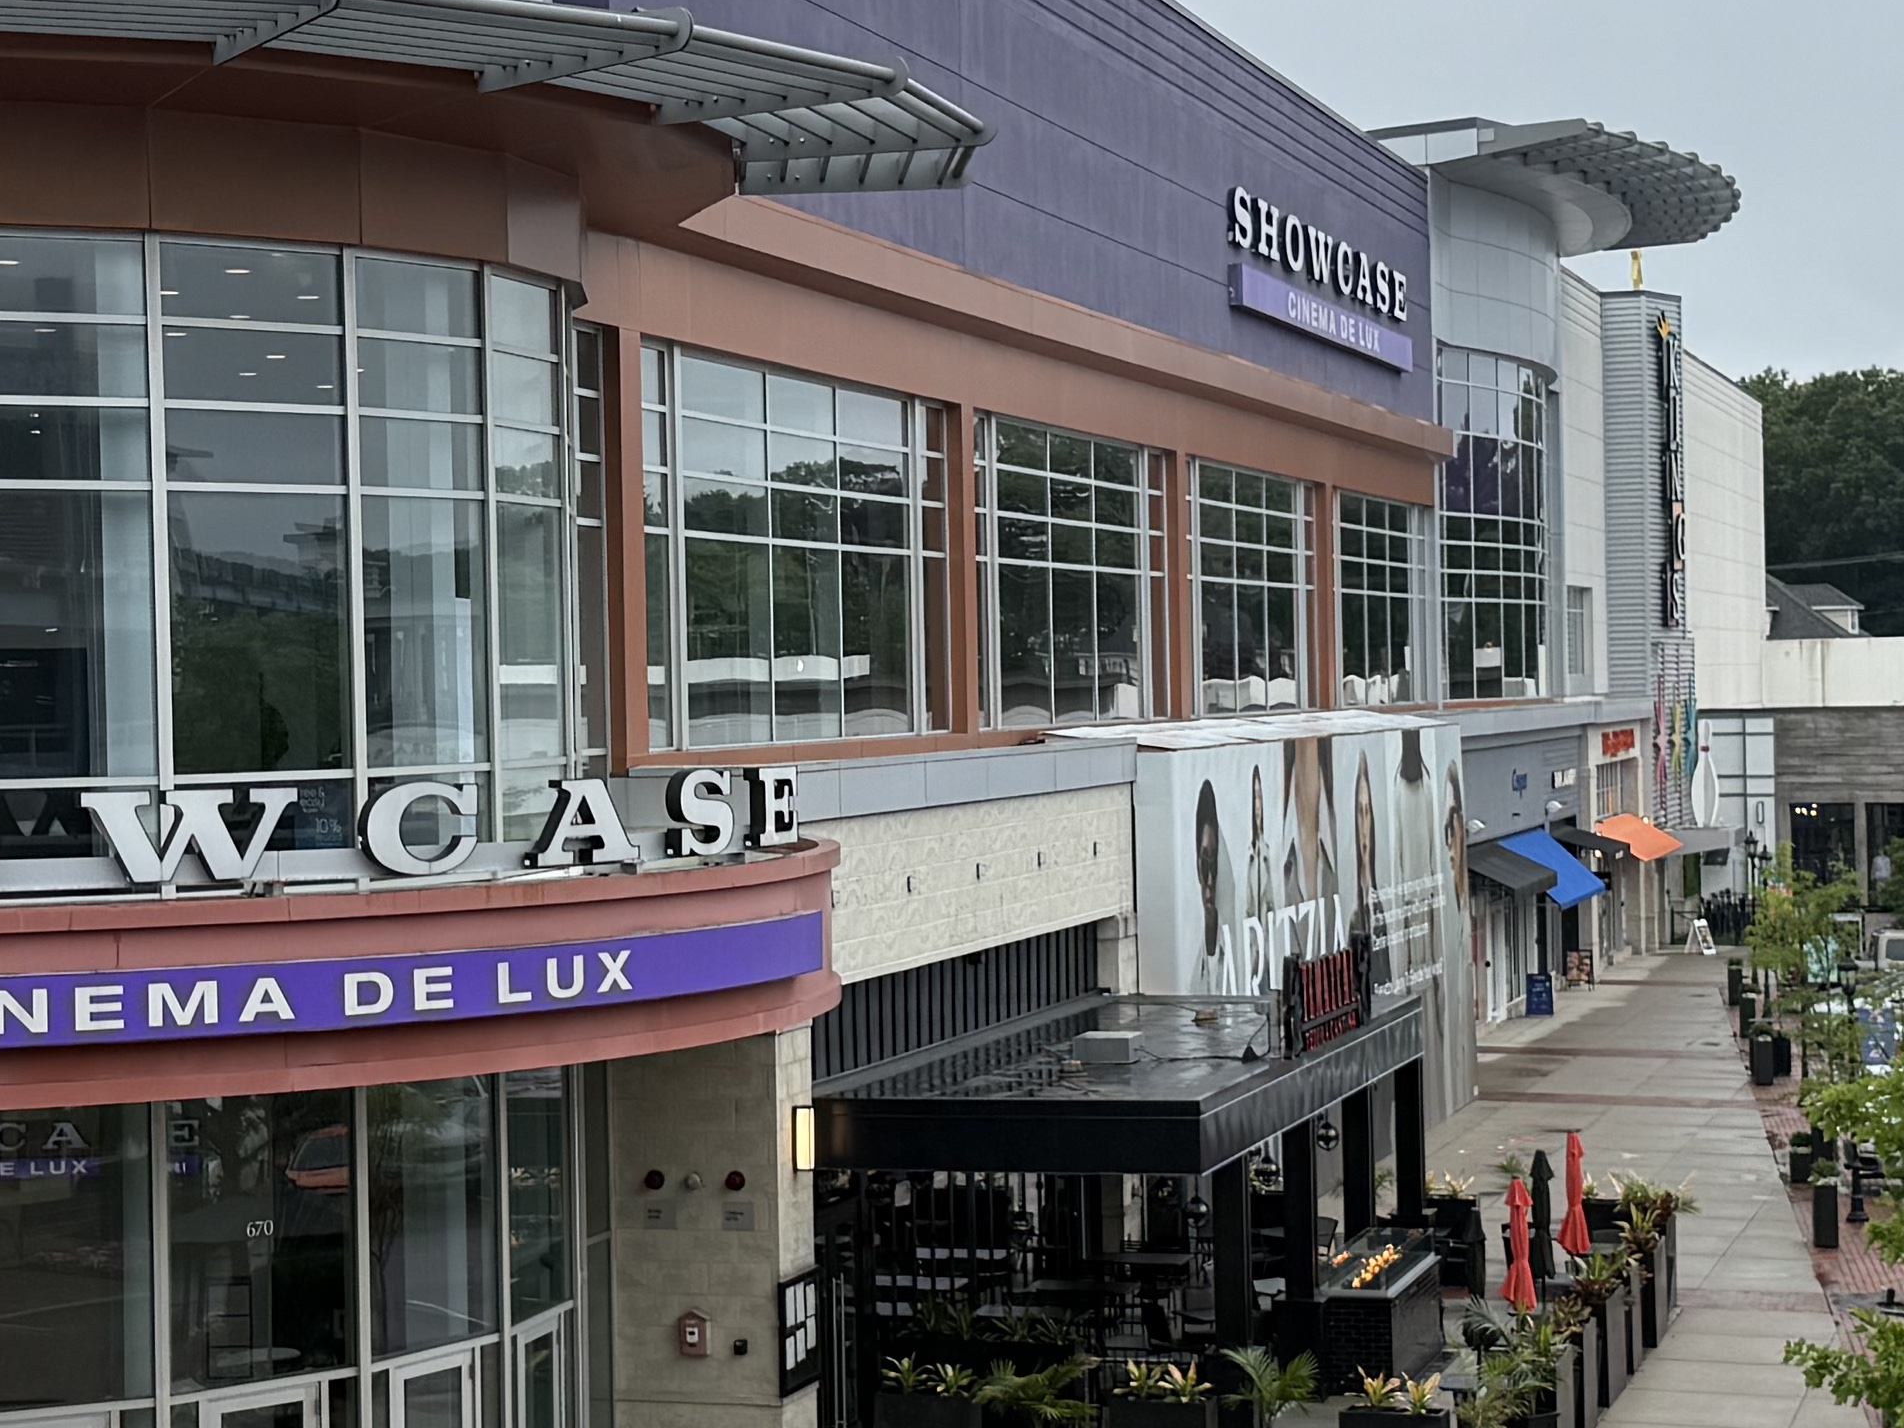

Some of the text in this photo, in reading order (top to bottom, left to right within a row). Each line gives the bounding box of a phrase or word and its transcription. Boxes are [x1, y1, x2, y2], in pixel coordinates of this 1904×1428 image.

[1232, 185, 1407, 322] SHOWCASE
[1288, 291, 1380, 353] CINEMA DE LUX
[1668, 336, 1686, 621] KINGS
[1222, 894, 1347, 996] ARITZIA
[344, 965, 455, 1018] DE
[498, 949, 633, 1005] LUX
[30, 1160, 88, 1175] LUX
[247, 1219, 274, 1238] 670
